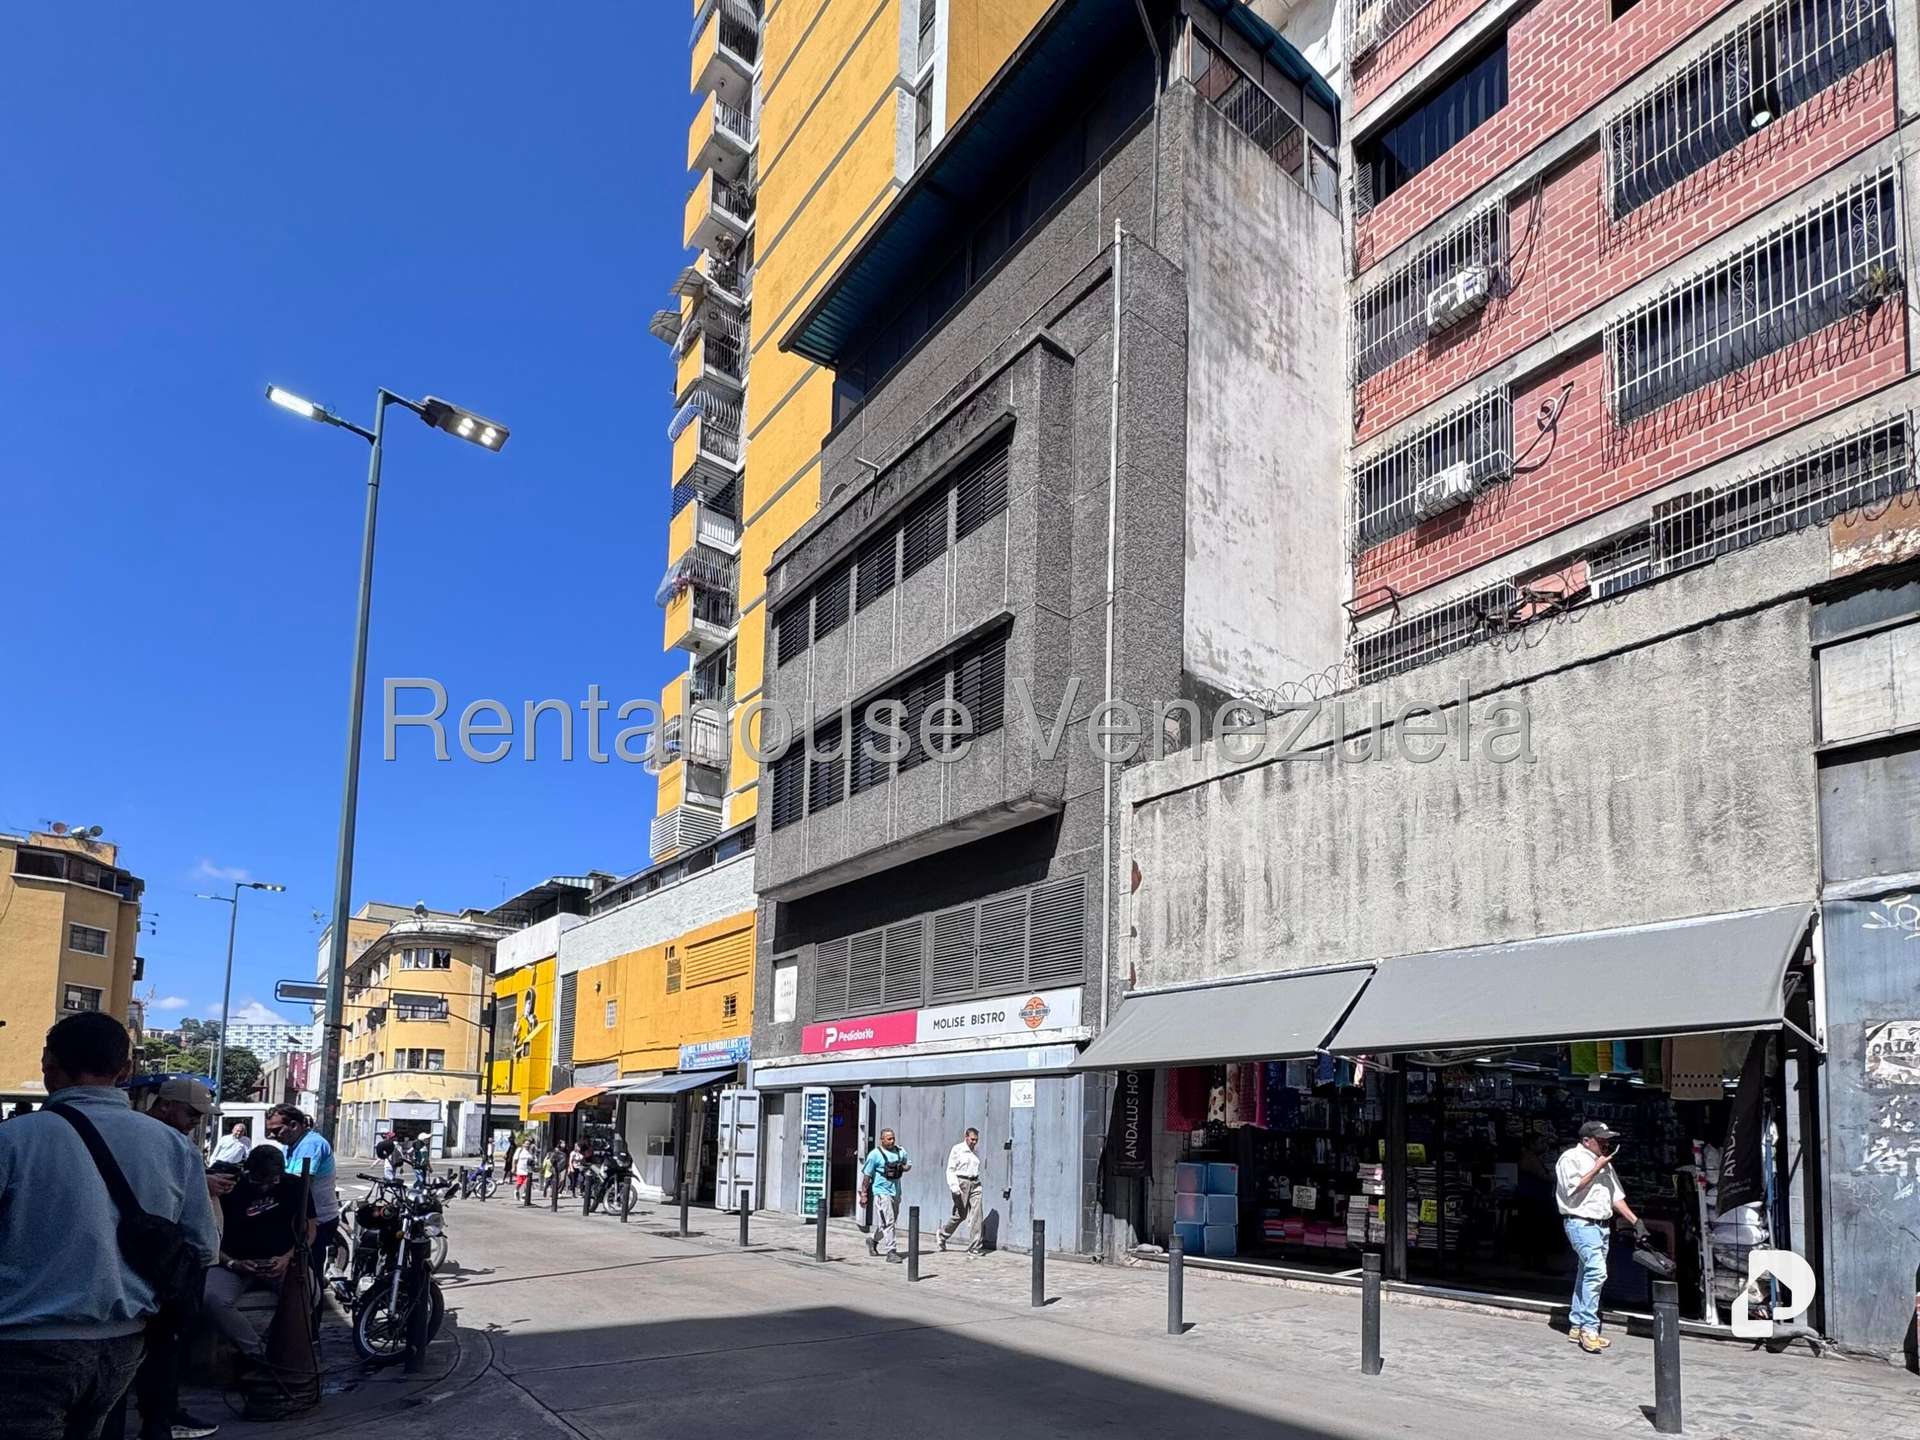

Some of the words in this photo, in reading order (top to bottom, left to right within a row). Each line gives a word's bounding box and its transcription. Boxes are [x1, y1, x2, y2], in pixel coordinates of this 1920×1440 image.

[933, 1016, 965, 1030] MOLISE
[971, 1011, 1006, 1026] BISTRO
[838, 1028, 874, 1043] PedidosYa
[1125, 1097, 1139, 1160] ANDALUS
